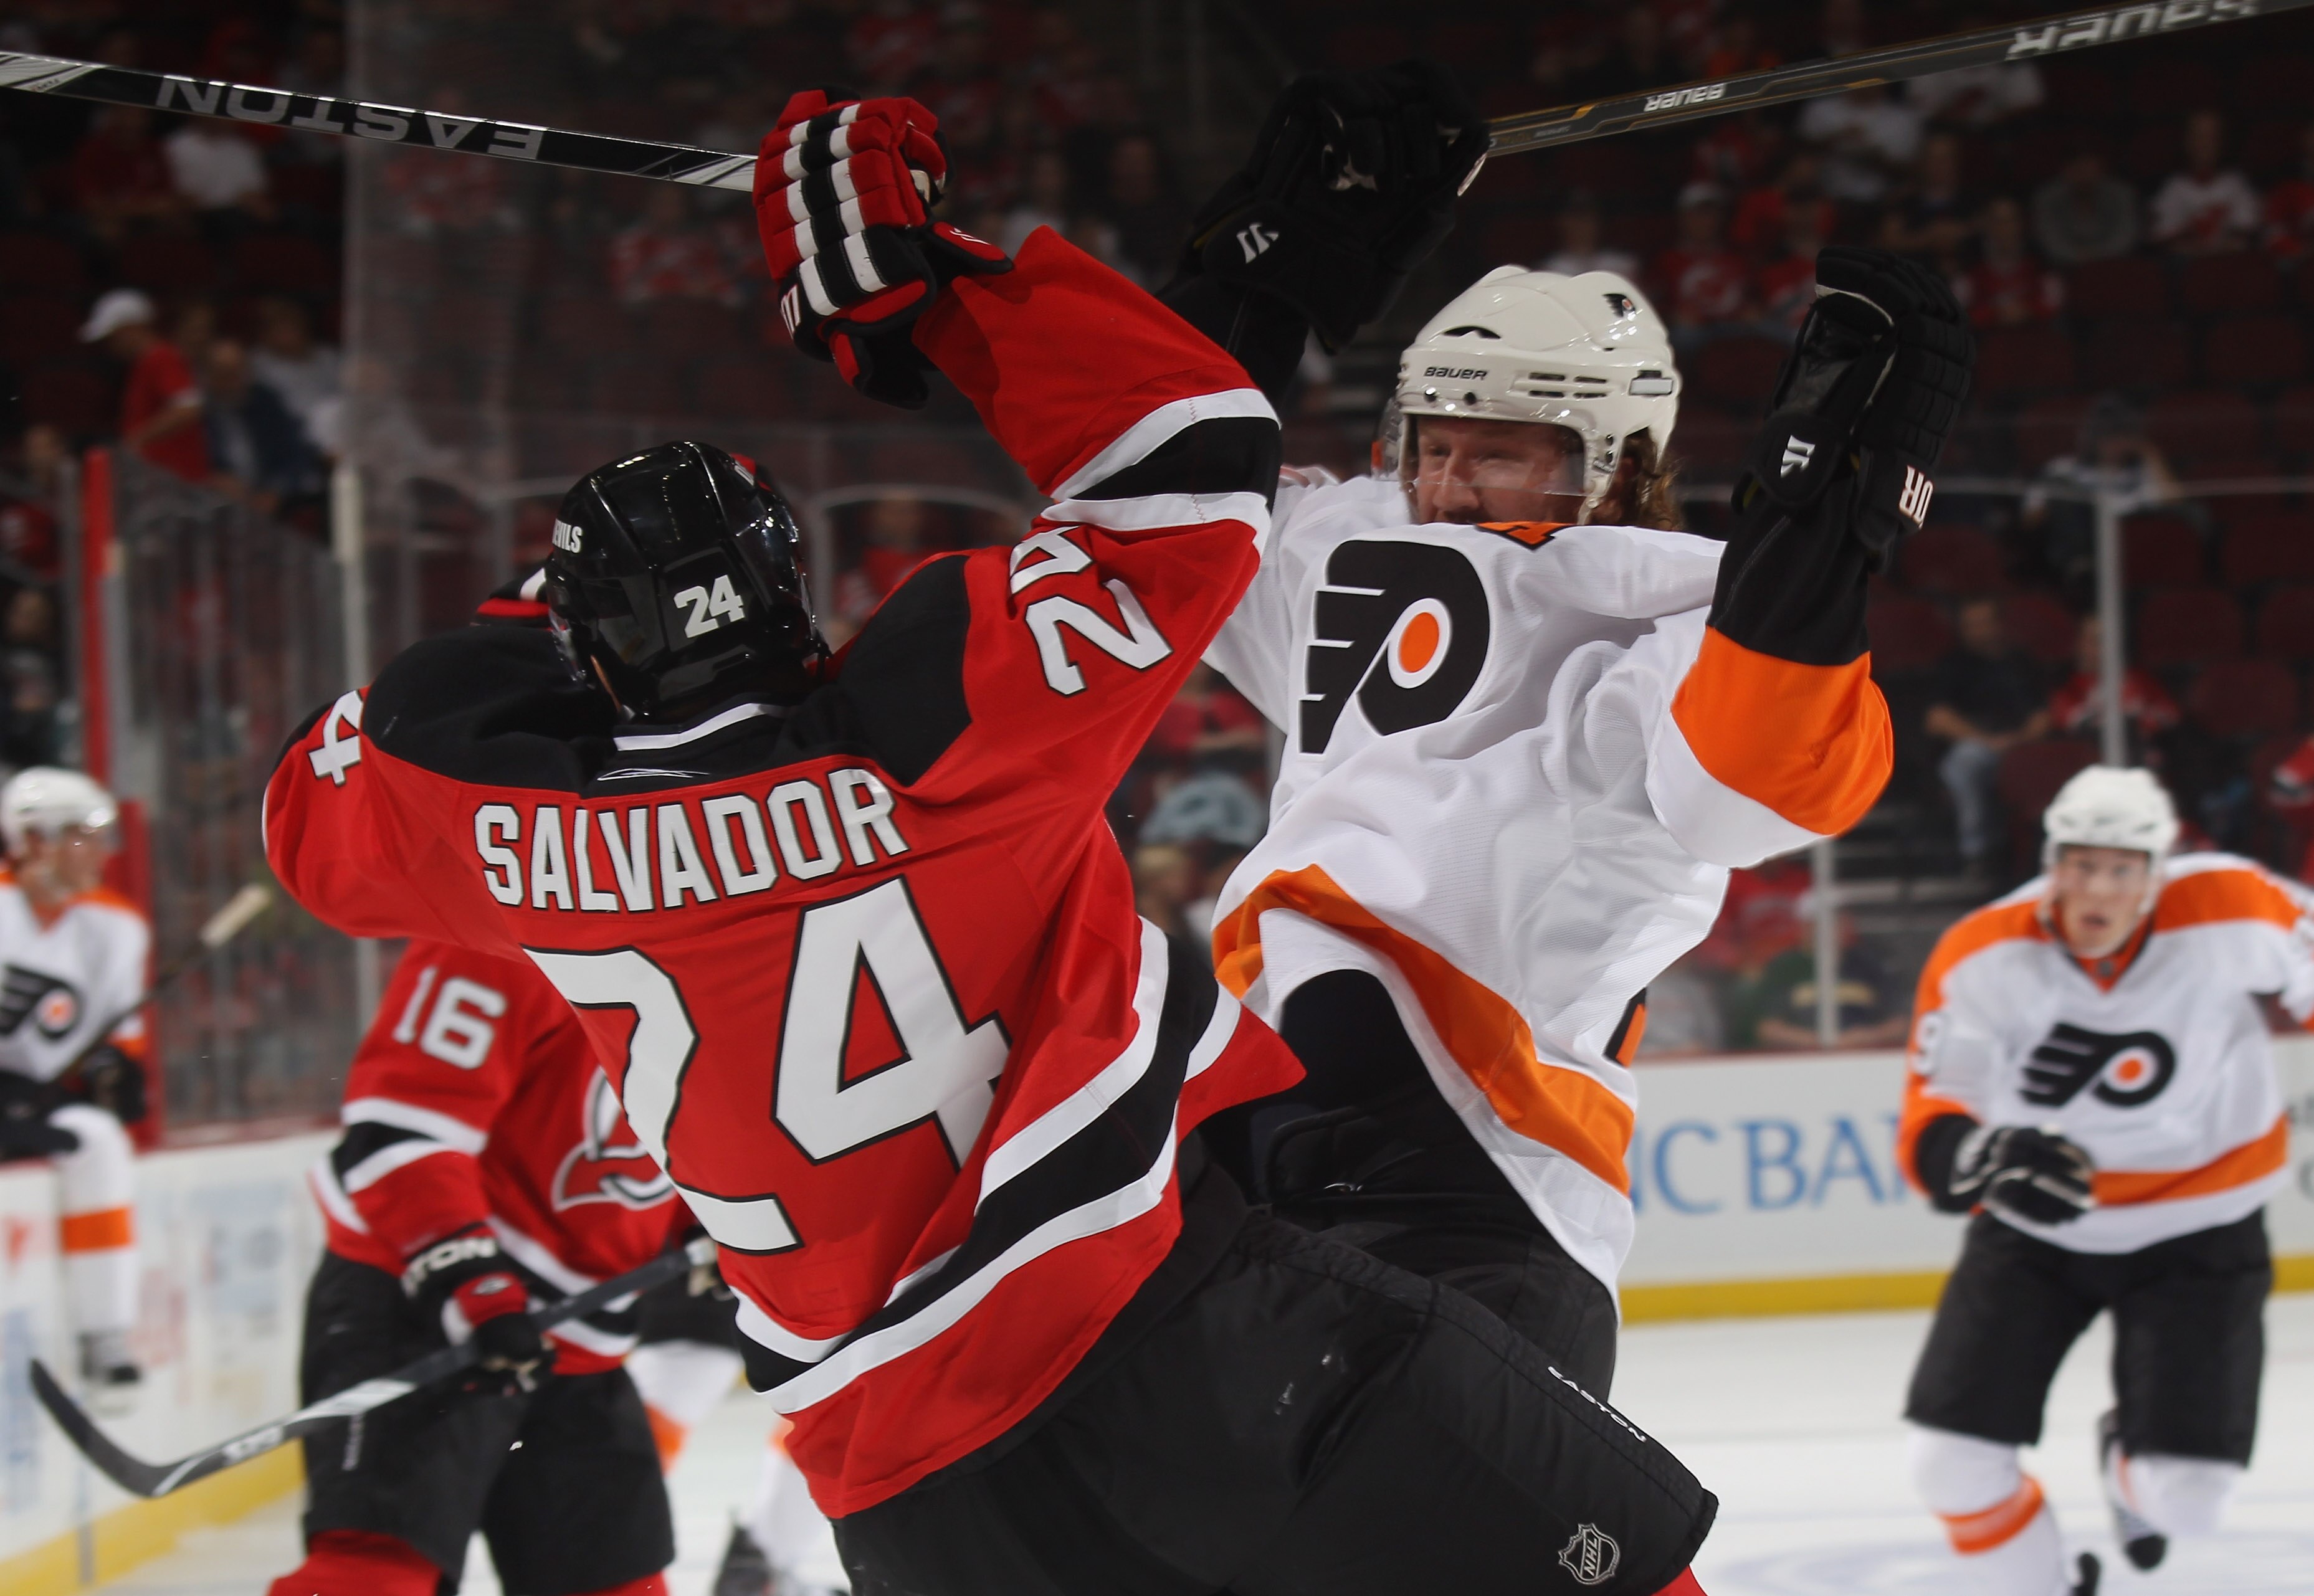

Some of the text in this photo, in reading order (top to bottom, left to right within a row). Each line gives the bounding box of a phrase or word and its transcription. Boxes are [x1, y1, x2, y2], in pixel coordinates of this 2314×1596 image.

[155, 75, 550, 160] EASTON
[1643, 83, 1727, 113] BAUER
[1424, 366, 1488, 381] BAUER
[673, 574, 745, 639] 24
[1009, 525, 1174, 698] 24
[474, 768, 910, 913] SALVADOR
[393, 964, 508, 1070] 16
[520, 861, 1013, 1255] 24
[1737, 1115, 1910, 1211] BA
[1548, 1366, 1647, 1442] EASTON
[1584, 1537, 1599, 1577] NHL
